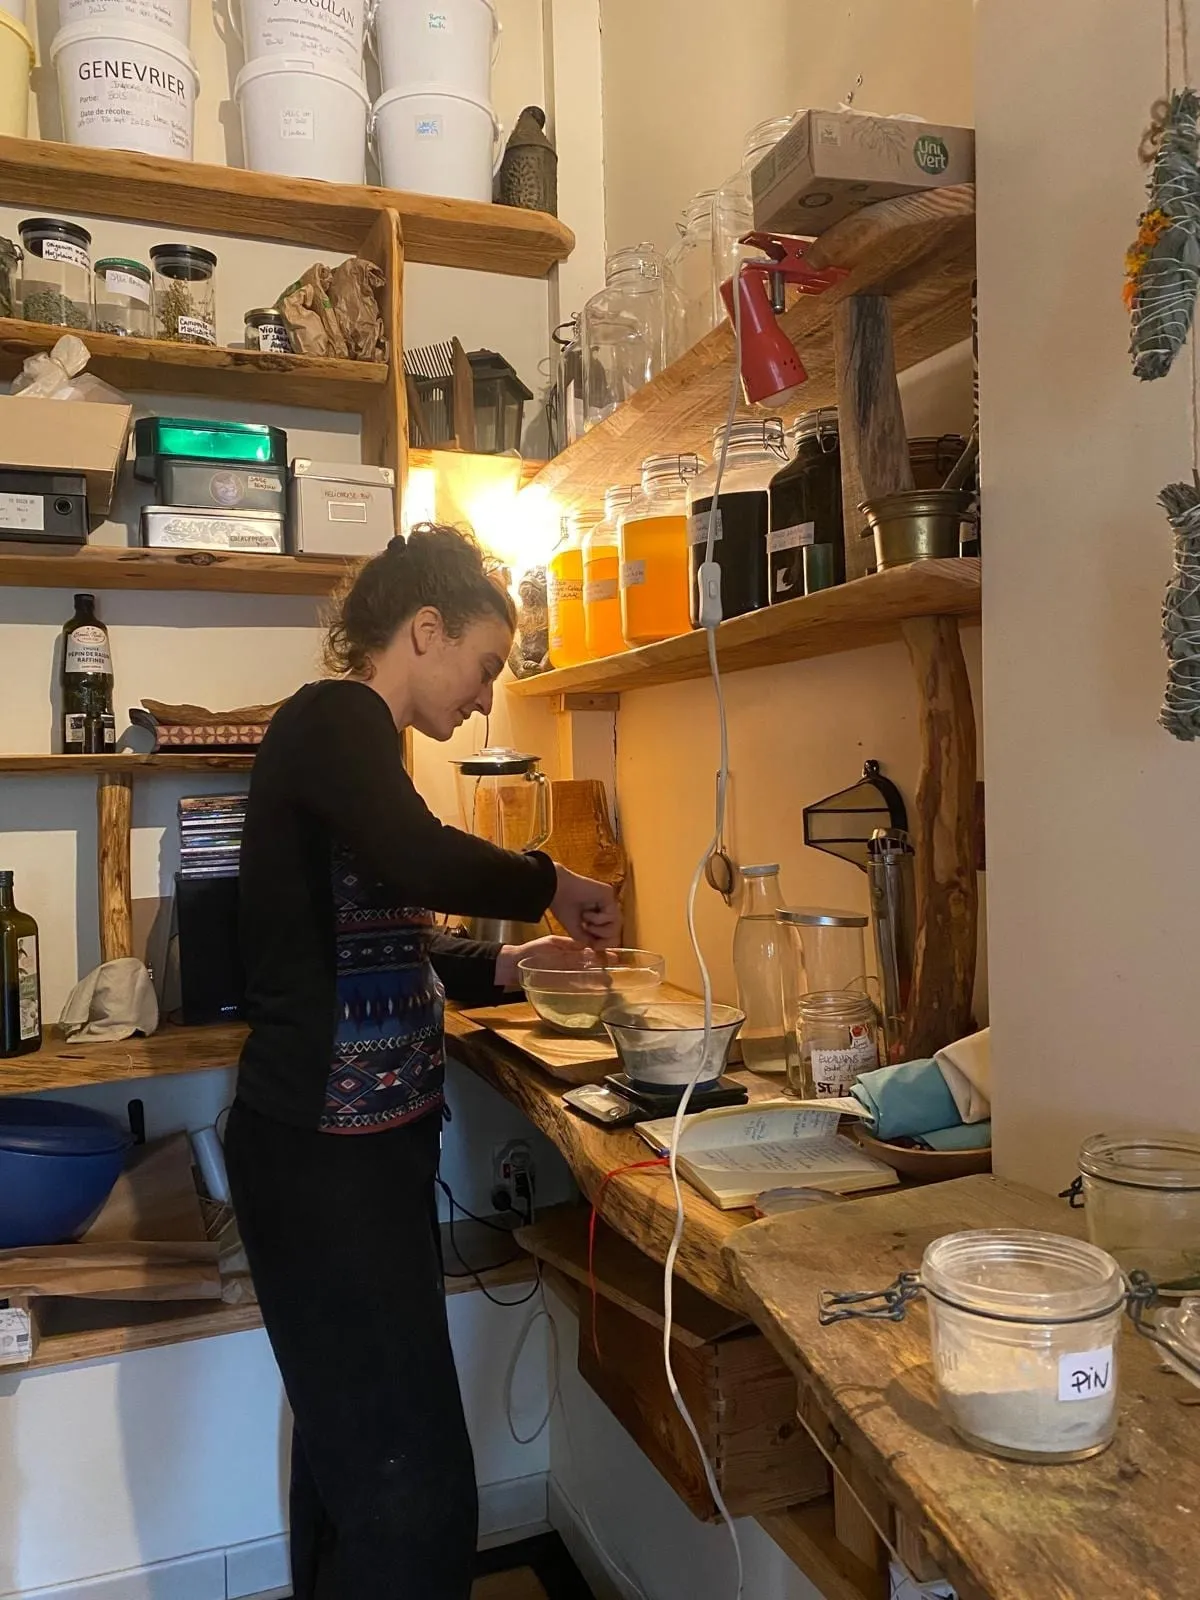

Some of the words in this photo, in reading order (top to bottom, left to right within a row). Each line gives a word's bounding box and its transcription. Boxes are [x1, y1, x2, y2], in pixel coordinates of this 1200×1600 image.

[78, 60, 186, 100] GENEVRIER
[80, 109, 94, 118] Date
[95, 108, 104, 116] de
[918, 140, 942, 155] Uni
[916, 150, 946, 169] Vert
[817, 1082, 834, 1094] ST
